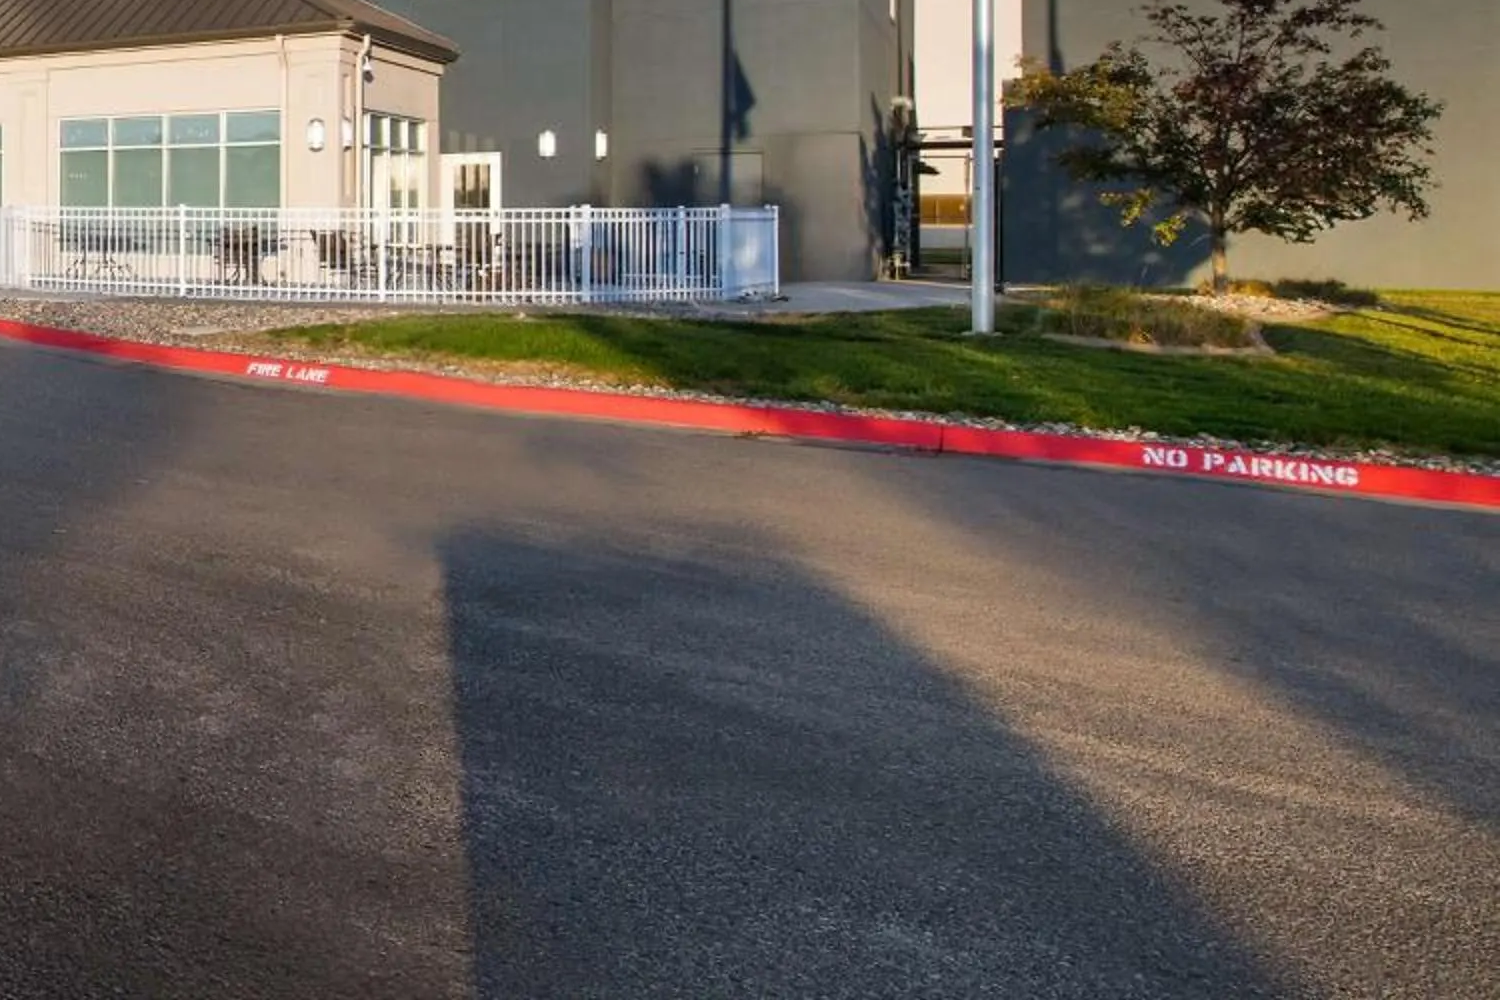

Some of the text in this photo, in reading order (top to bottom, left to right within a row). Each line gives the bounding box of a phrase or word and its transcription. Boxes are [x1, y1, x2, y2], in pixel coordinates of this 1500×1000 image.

[246, 362, 330, 382] FIRE LANE
[1142, 447, 1359, 487] NO PARKING
